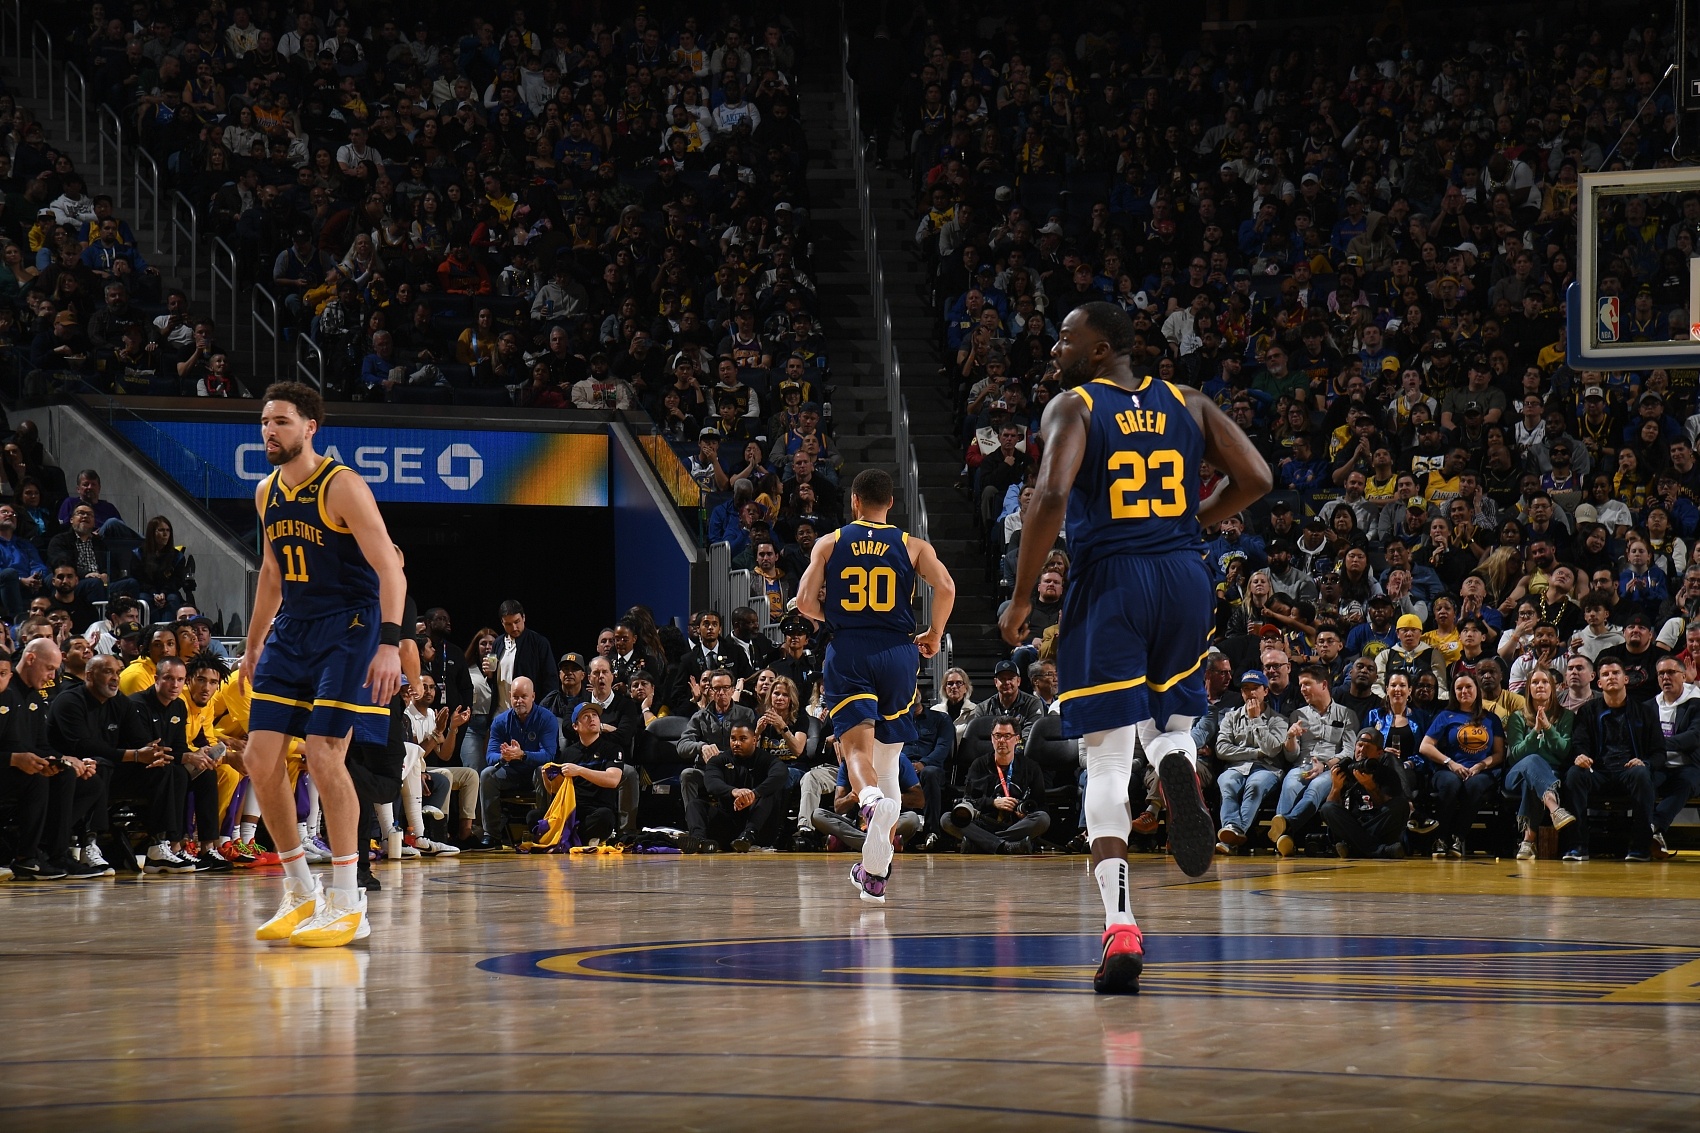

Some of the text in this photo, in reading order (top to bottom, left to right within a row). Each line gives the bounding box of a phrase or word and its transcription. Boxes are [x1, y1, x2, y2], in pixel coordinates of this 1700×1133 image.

[1601, 331, 1612, 339] NBA
[1114, 409, 1167, 435] GREEN
[1107, 449, 1188, 520] 23
[295, 520, 325, 547] STATE
[850, 540, 890, 557] CURRY
[281, 544, 310, 582] 11
[840, 566, 897, 612] 30
